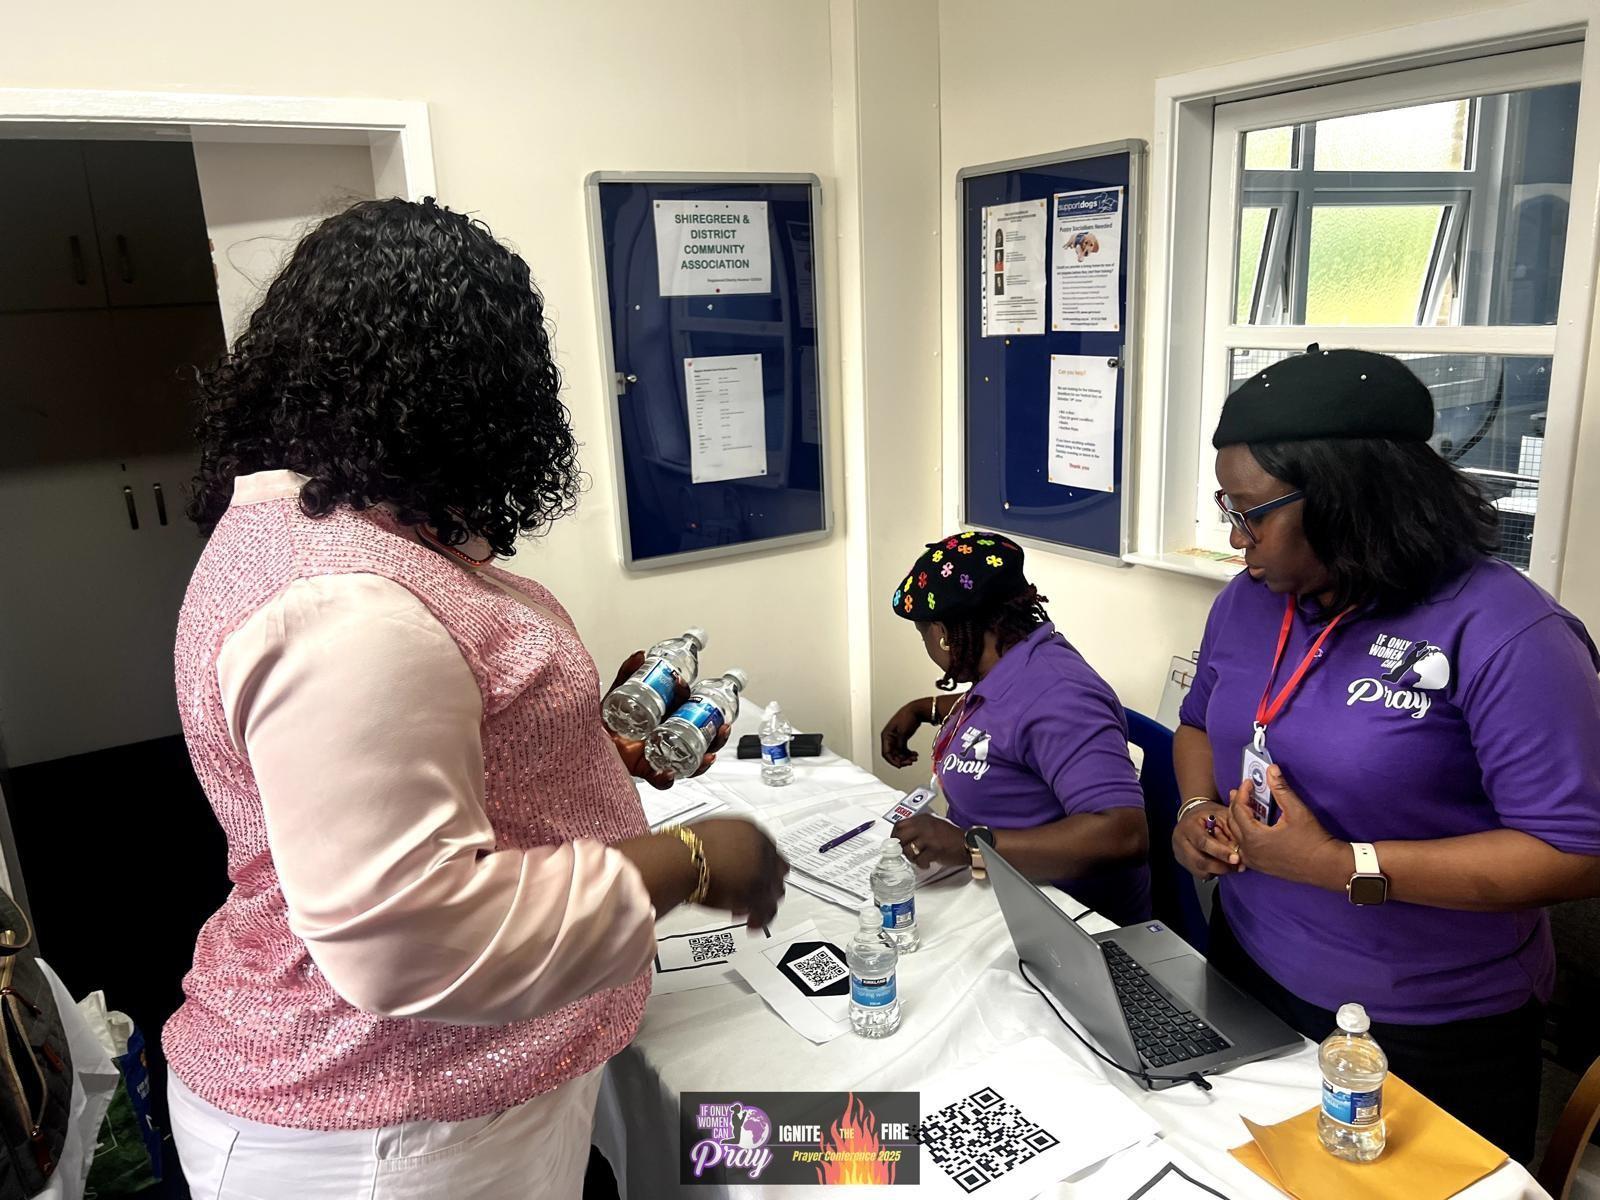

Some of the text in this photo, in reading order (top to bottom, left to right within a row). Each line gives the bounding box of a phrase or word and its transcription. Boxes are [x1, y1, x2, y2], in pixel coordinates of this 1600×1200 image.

[675, 214, 751, 224] SHIREGREEN &
[690, 229, 737, 240] DISTRICT
[684, 245, 745, 255] COMMUNITY
[681, 260, 750, 270] ASSOCIATION
[1376, 634, 1412, 650] IF ONLY
[1369, 644, 1404, 660] WOMEN
[1347, 678, 1431, 718] Pray
[943, 753, 990, 780] Pray
